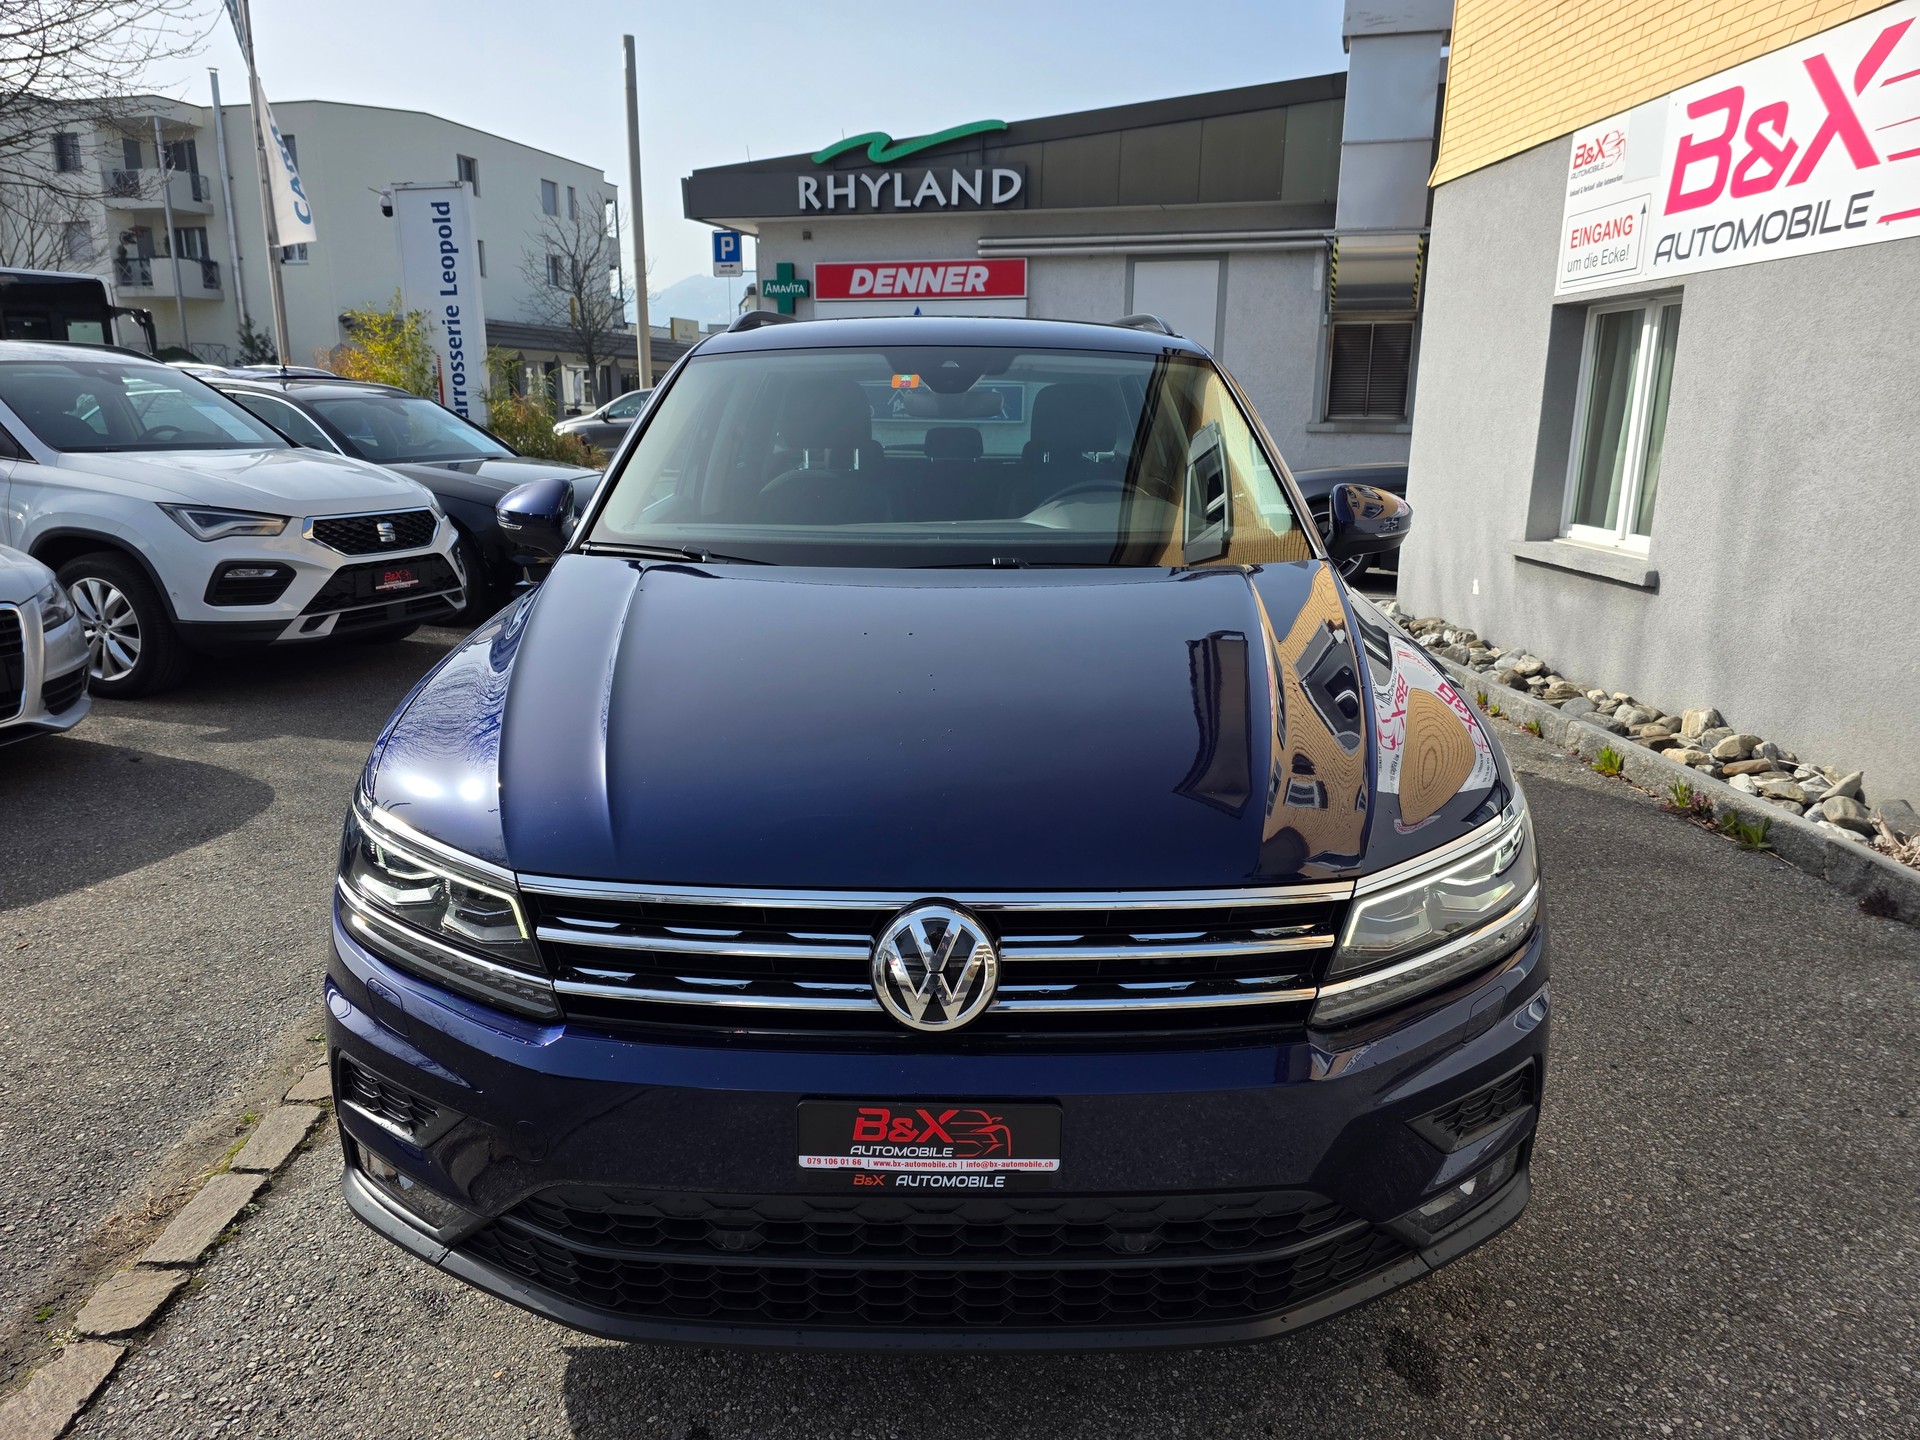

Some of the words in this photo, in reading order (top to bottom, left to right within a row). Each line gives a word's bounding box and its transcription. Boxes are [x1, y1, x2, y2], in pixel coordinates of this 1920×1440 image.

[1663, 16, 1917, 216] B&X
[1572, 133, 1610, 170] B&X
[798, 168, 1022, 210] RHYLAND
[1570, 214, 1634, 250] EINGANG
[1653, 189, 1875, 266] AUTOMOBILE
[430, 201, 459, 297] Leopold
[720, 236, 734, 260] P
[1567, 258, 1582, 273] um
[1583, 251, 1599, 269] die
[1601, 243, 1630, 266] Ecke!
[849, 265, 989, 295] DENNER
[852, 1107, 960, 1143] B&X
[806, 1157, 822, 1165] 079
[840, 1158, 850, 1166] 01
[852, 1158, 862, 1166] 66
[873, 1160, 957, 1168] www.bx-automobile.ch
[966, 1161, 1054, 1169] info@bx-automobile.ch
[850, 1145, 954, 1157] AUTOMOBILE
[853, 1174, 886, 1186] B&X
[895, 1174, 1006, 1188] AUTOMOBILE
